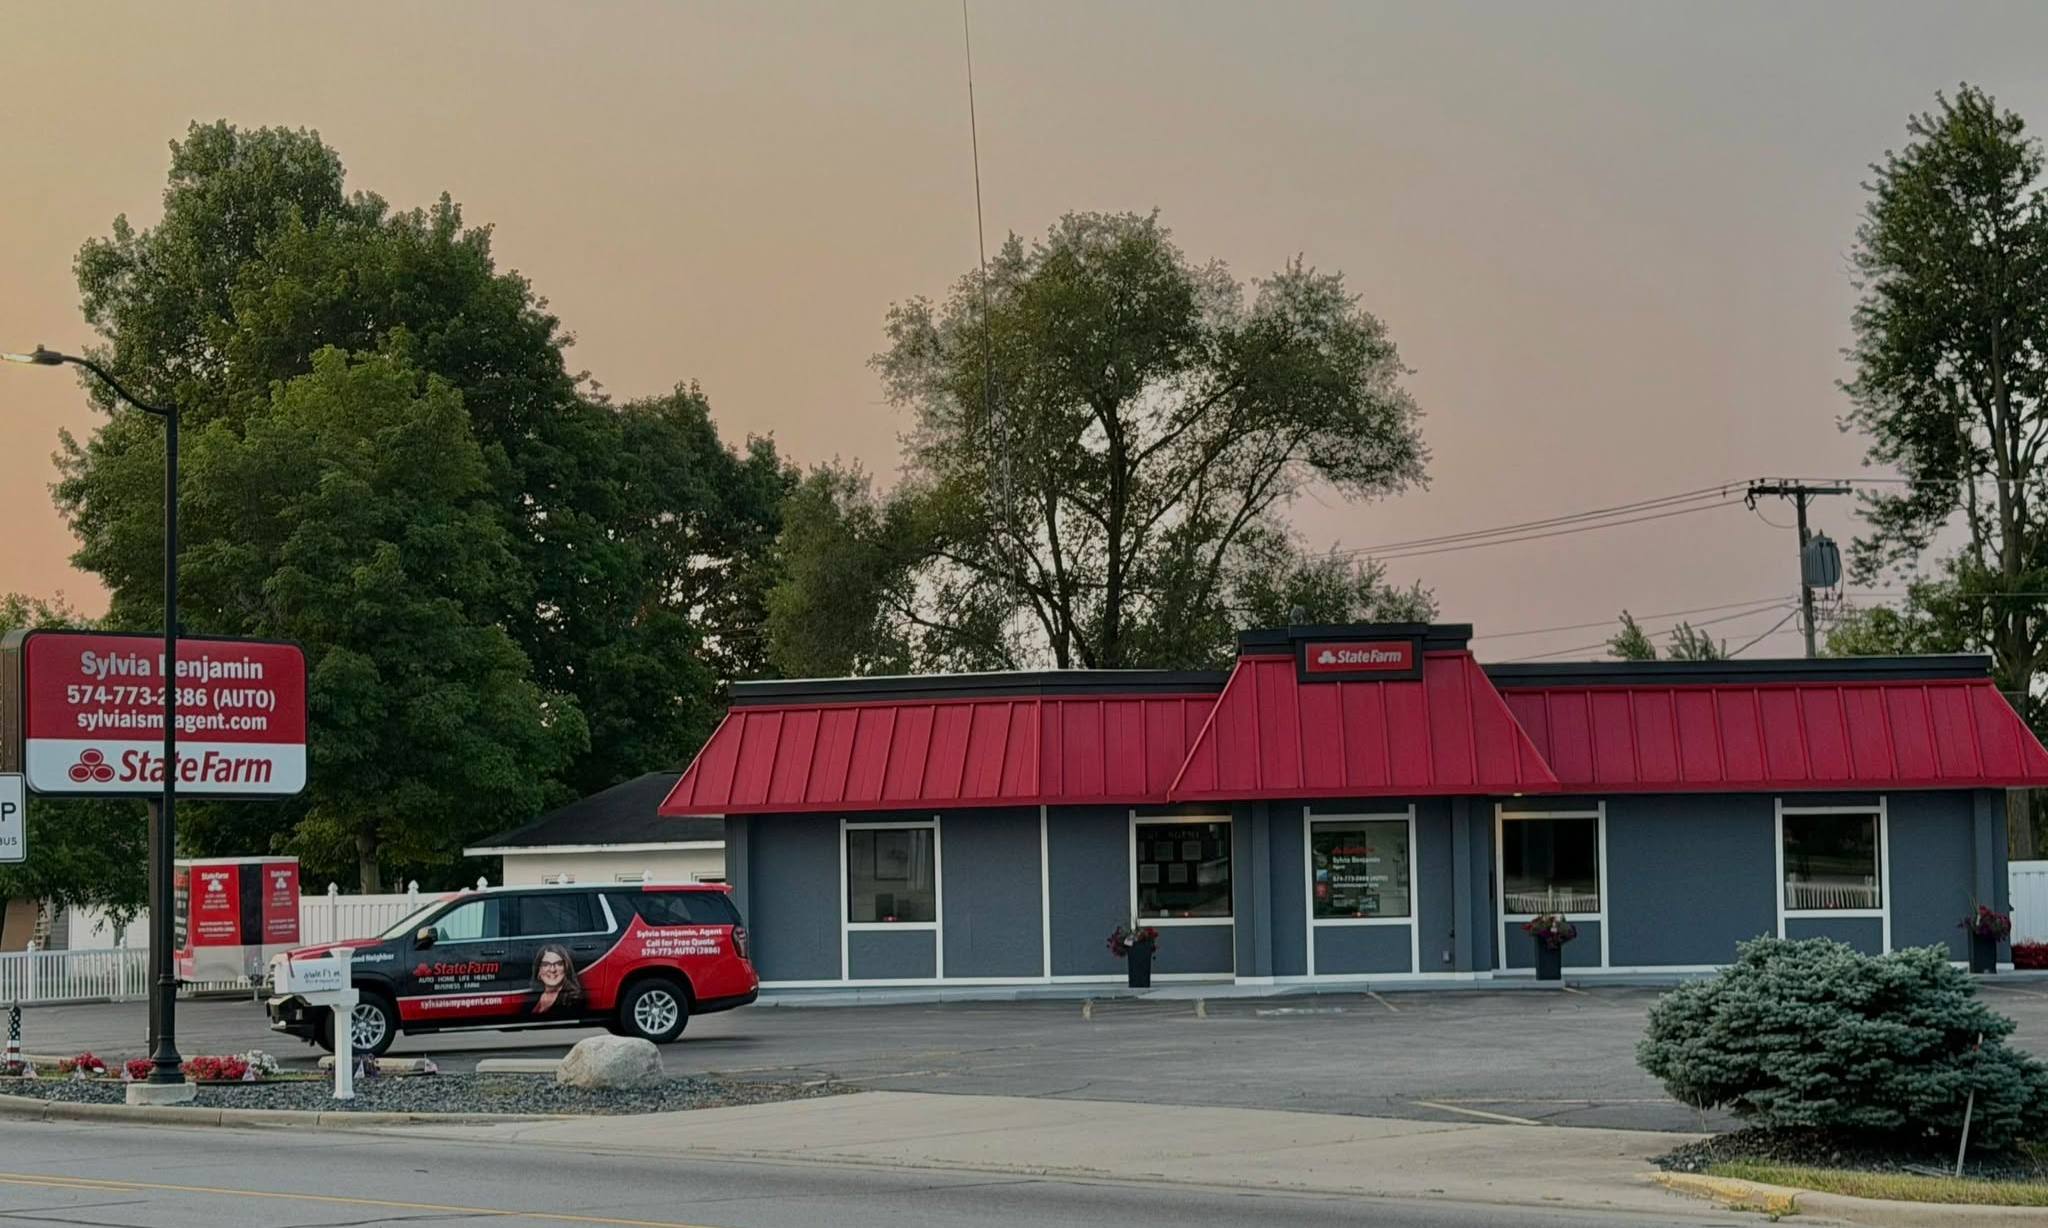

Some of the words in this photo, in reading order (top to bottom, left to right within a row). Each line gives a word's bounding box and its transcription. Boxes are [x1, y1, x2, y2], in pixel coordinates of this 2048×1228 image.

[81, 650, 151, 681] Sylvia
[213, 688, 276, 712] (AUTO)
[77, 709, 267, 732] sylviaismagent.com
[0, 836, 17, 846] US
[636, 930, 659, 938] Sylvia
[699, 928, 722, 936] Agent
[674, 939, 690, 947] Free
[692, 938, 715, 946] Quote
[366, 953, 394, 963] Neighbor
[418, 976, 434, 984] AUTO
[458, 974, 470, 982] LIFE
[474, 973, 496, 981] HEALTH
